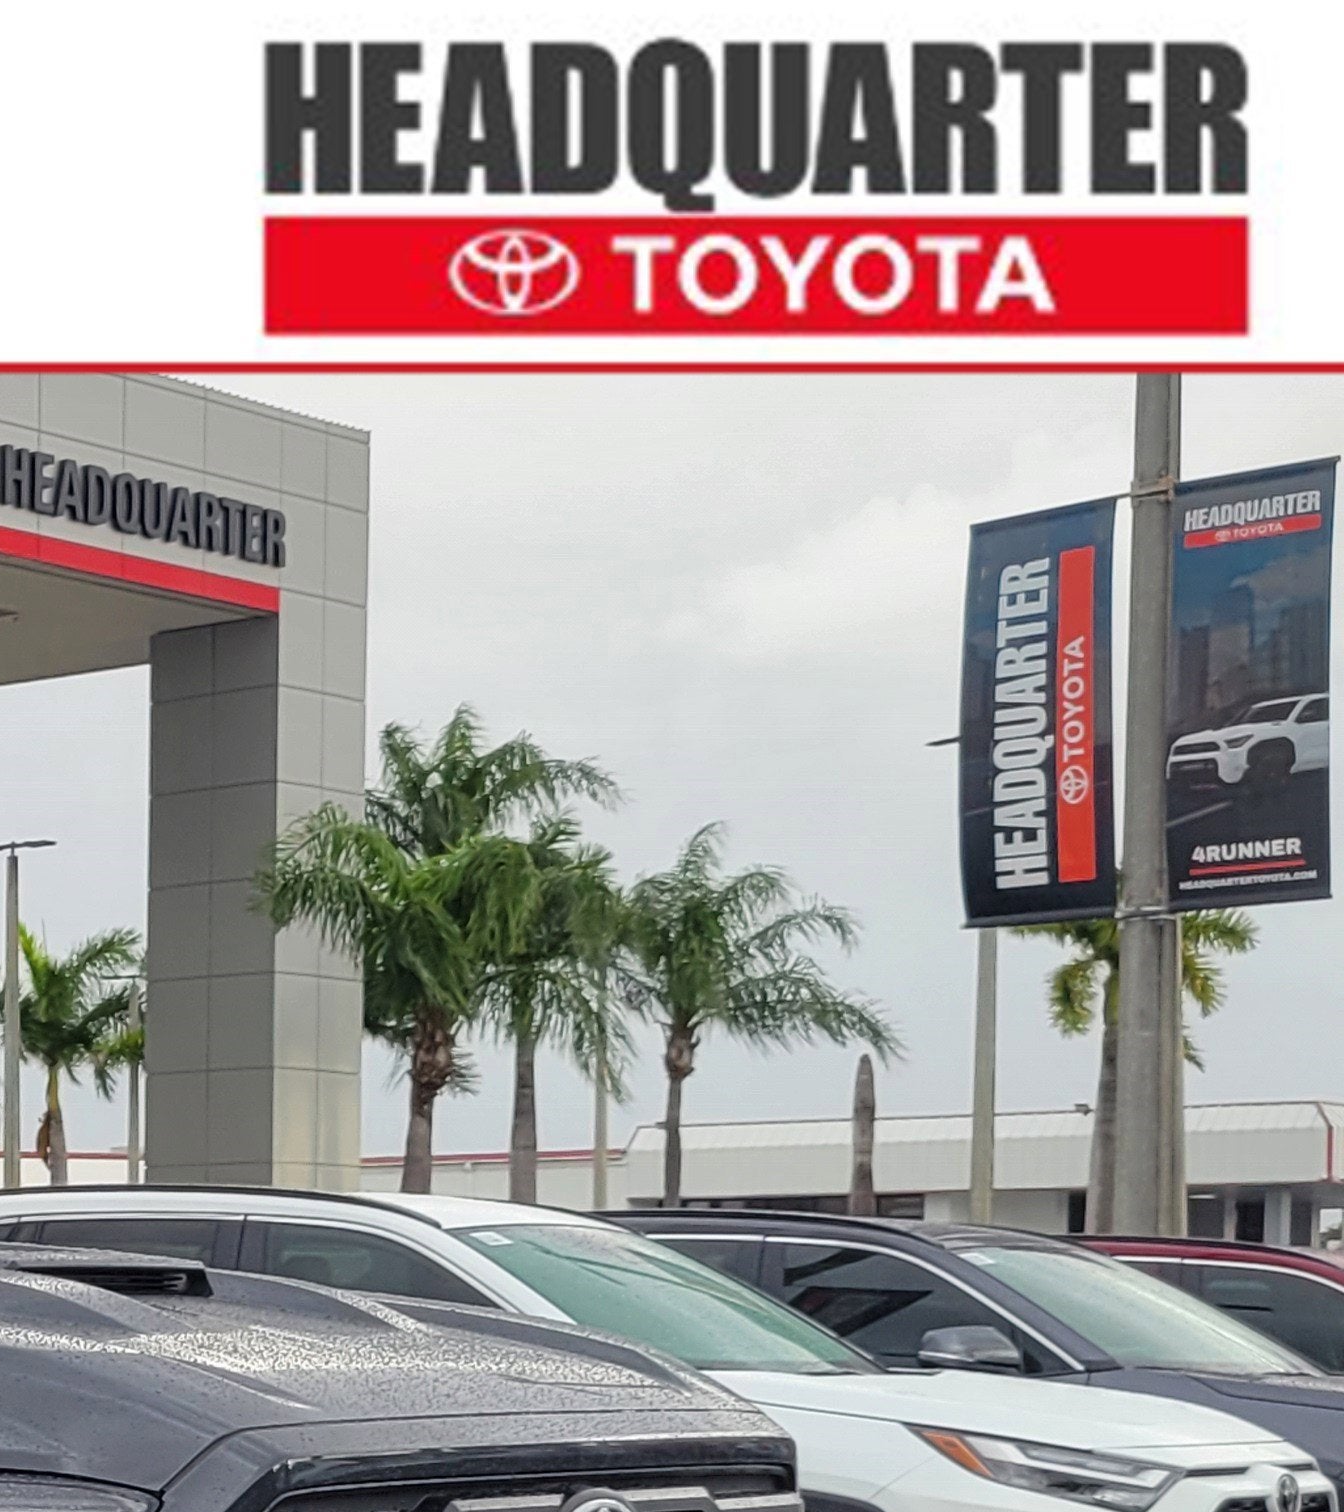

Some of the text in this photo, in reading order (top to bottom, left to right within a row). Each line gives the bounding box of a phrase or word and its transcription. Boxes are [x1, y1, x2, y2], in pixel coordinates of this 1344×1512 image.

[1184, 489, 1322, 532] HEADQUARTER
[1233, 522, 1285, 539] TOYOTA
[1062, 636, 1086, 763] TOYOTA
[993, 556, 1055, 890] HEADQUARTER
[1191, 837, 1303, 864] 4RUNNER
